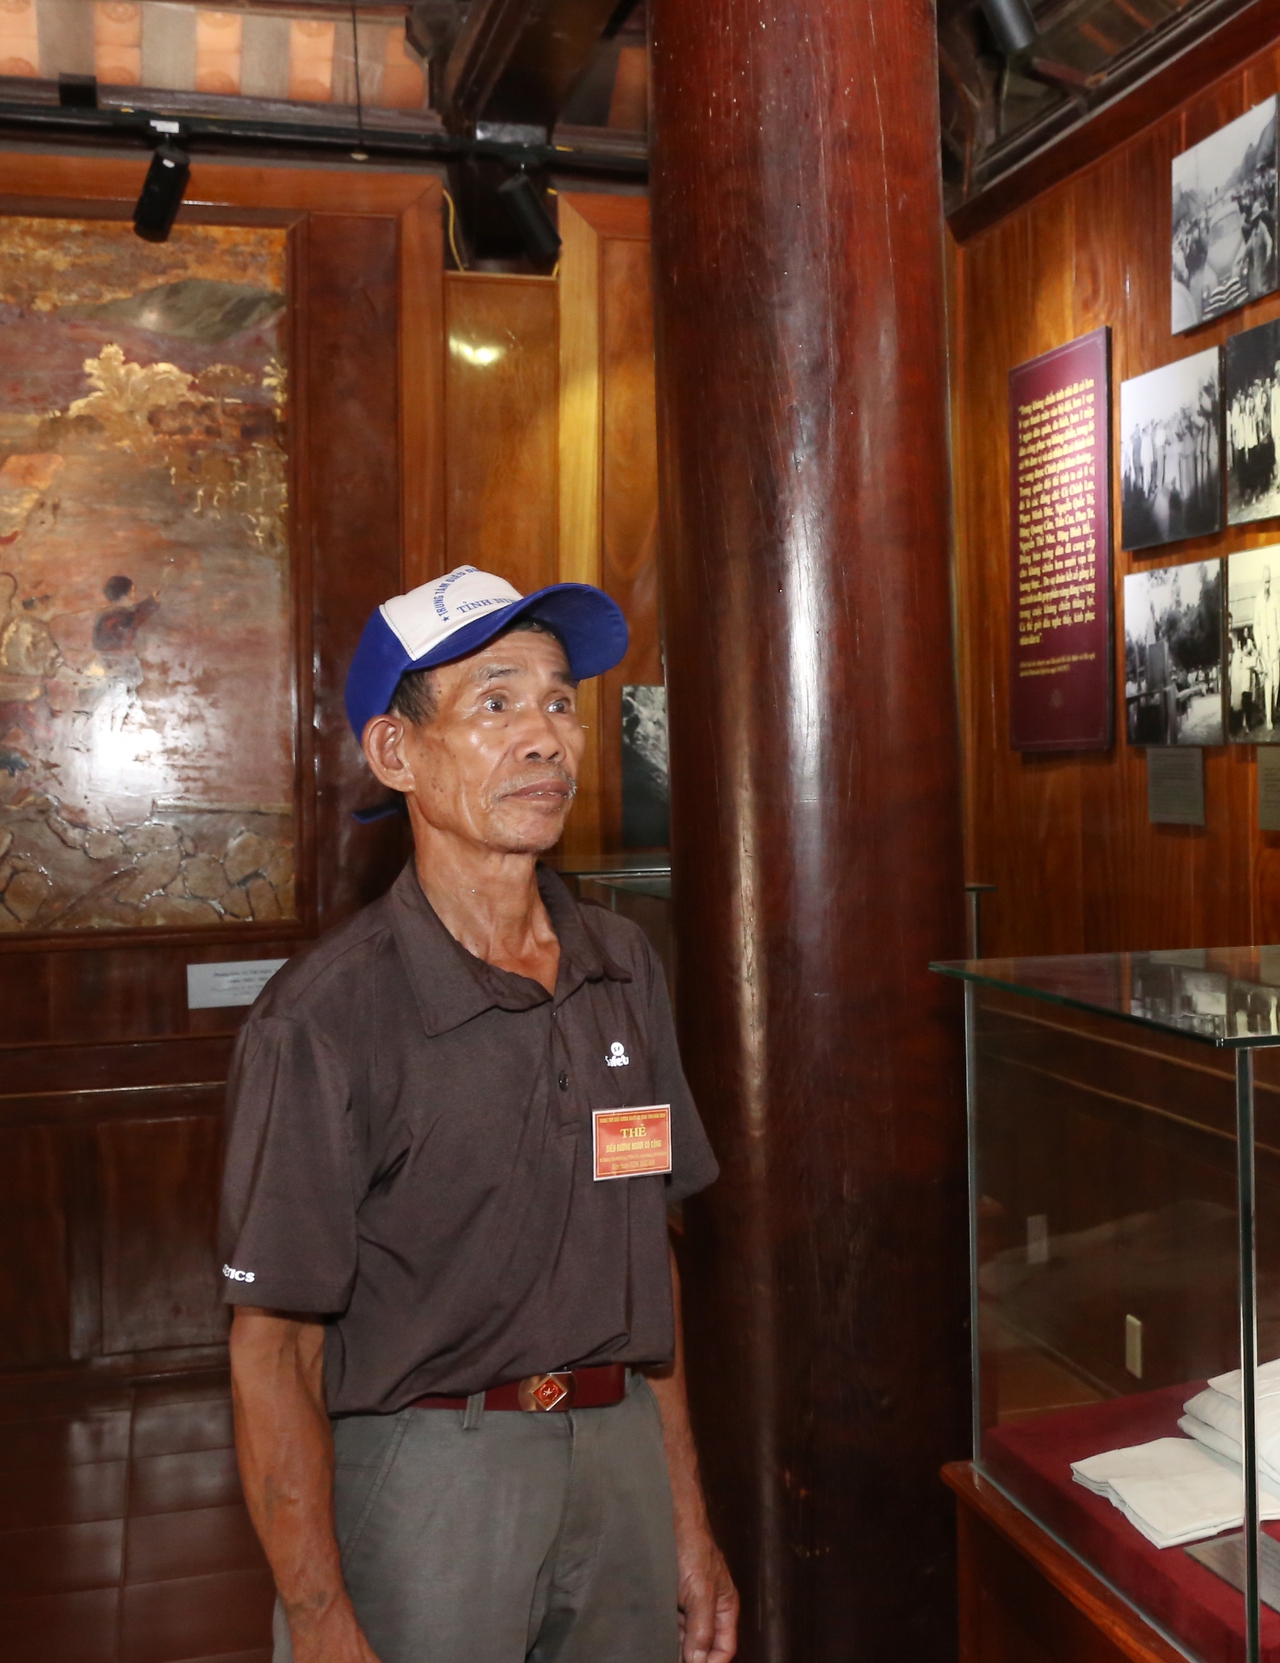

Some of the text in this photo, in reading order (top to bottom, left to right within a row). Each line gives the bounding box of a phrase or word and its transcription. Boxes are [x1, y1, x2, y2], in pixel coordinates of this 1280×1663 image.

[433, 595, 448, 616] TRUNG
[456, 599, 493, 613] TỈNH
[620, 1124, 647, 1139] THẺ
